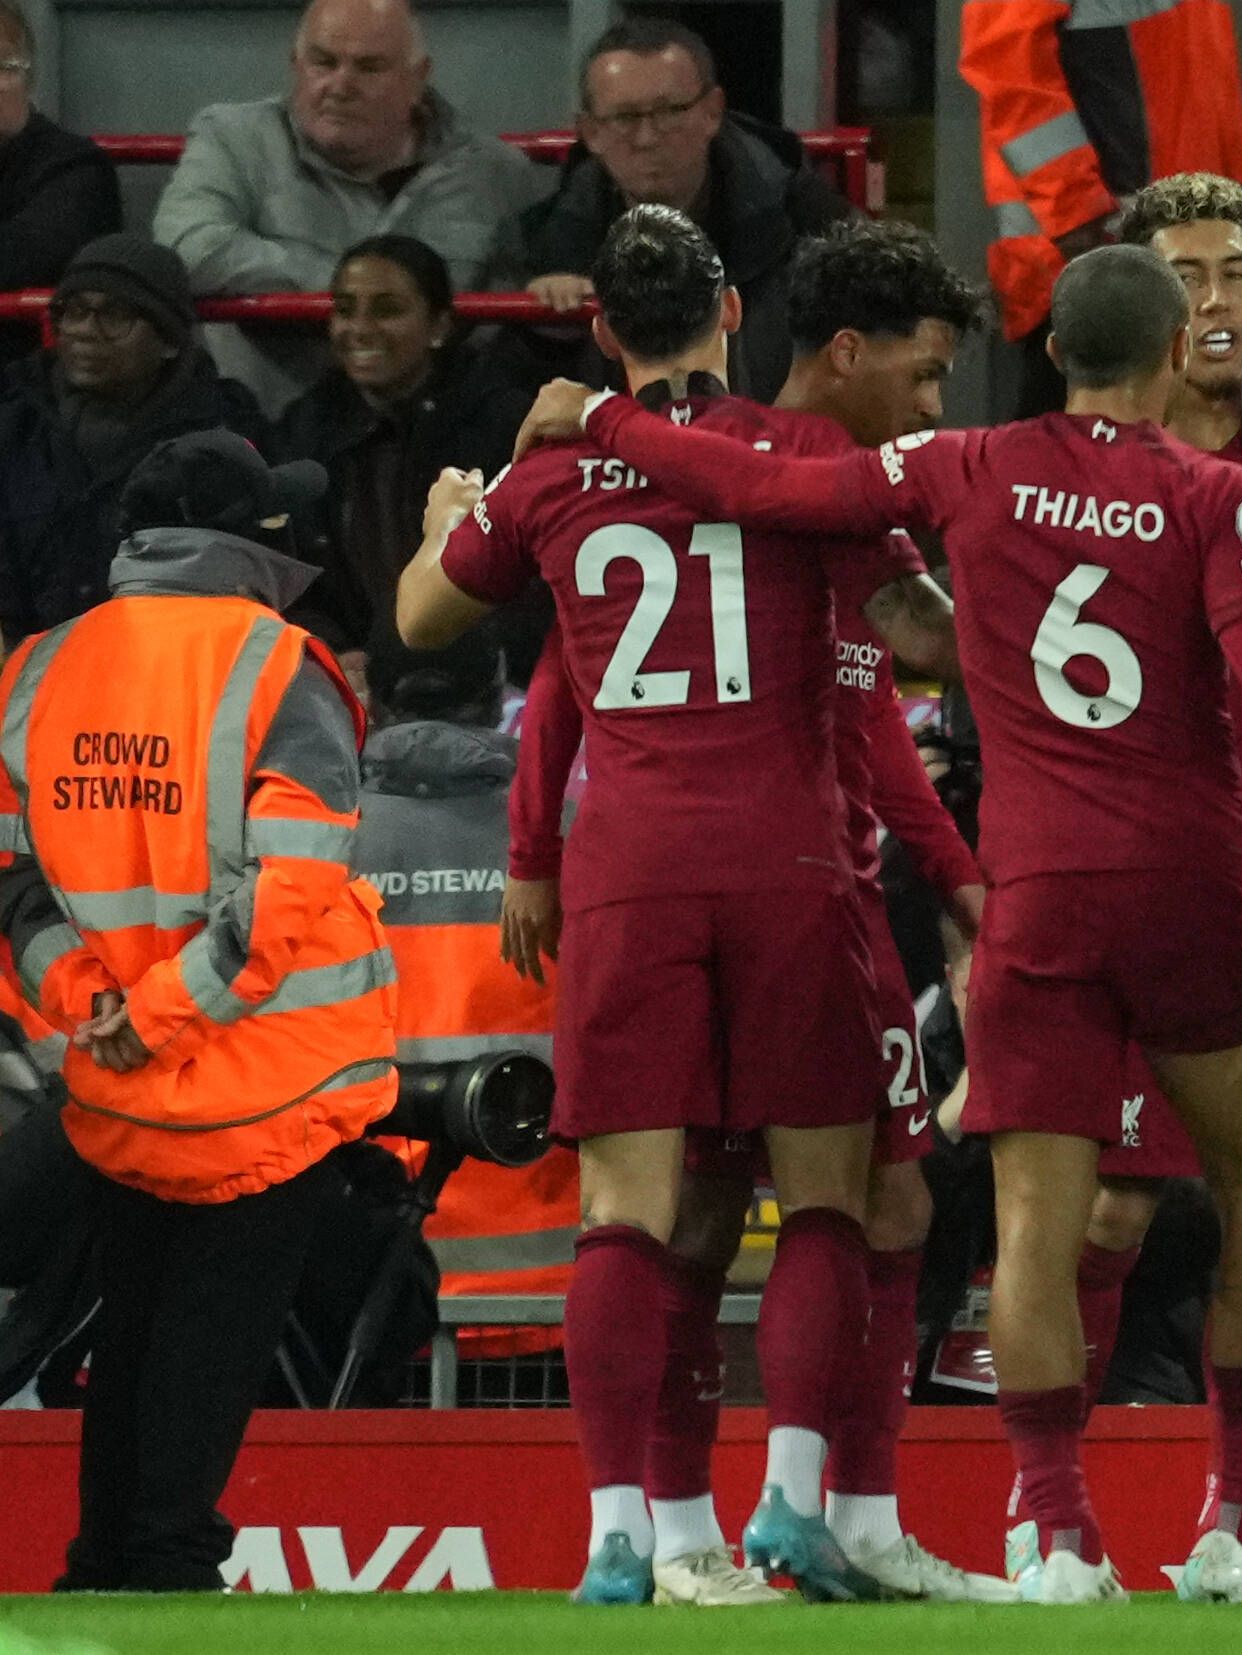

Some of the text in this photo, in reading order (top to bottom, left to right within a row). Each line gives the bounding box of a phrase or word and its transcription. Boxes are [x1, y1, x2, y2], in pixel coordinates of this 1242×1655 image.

[1011, 483, 1166, 543] THIAGO
[574, 521, 752, 711] 21
[1030, 563, 1143, 730] 6
[73, 731, 170, 768] CROWD
[53, 775, 183, 816] STEWARD
[411, 869, 505, 896] STEWA
